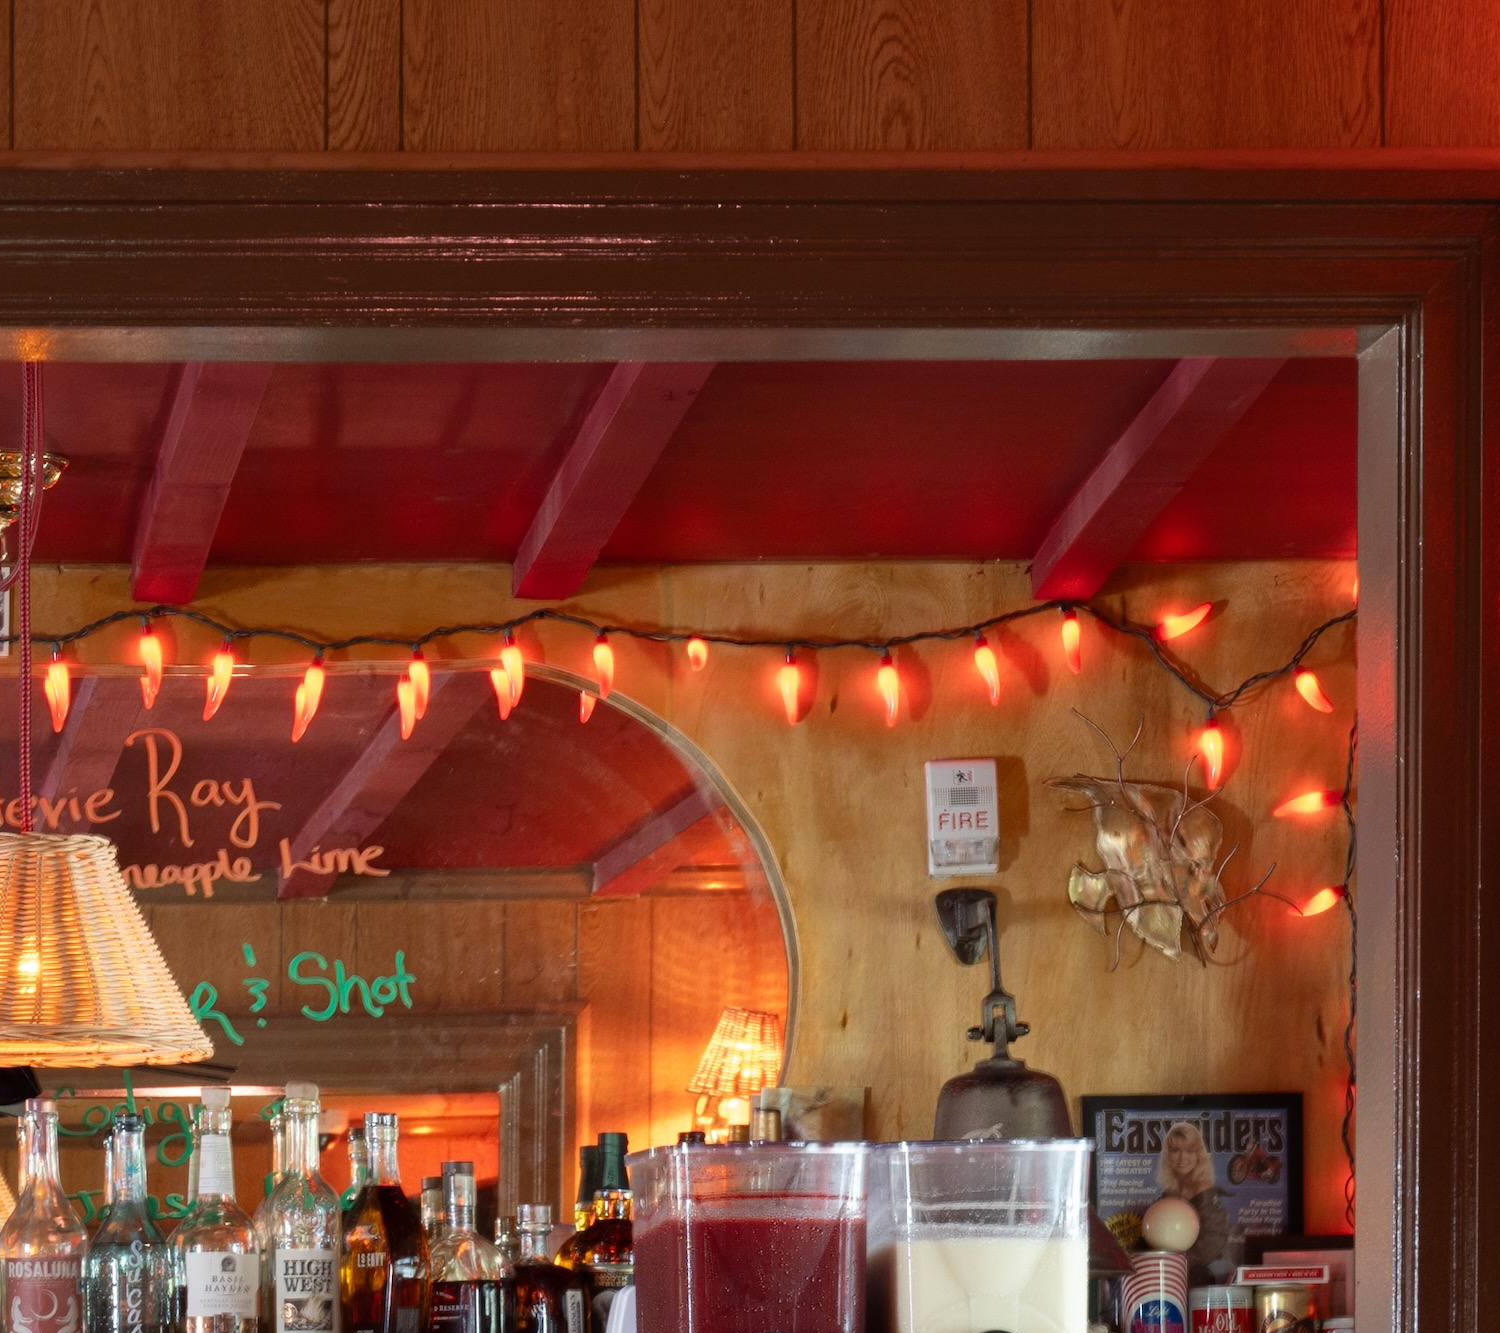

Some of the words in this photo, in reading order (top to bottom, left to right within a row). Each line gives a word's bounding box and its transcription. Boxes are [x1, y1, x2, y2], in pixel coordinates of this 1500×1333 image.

[124, 727, 282, 848] Ray
[938, 810, 989, 832] FIRE
[280, 837, 390, 877] Lime
[289, 948, 417, 1021] Shot
[8, 1260, 79, 1279] ROSALUNA
[283, 1258, 333, 1277] HIGH
[212, 1275, 246, 1284] BASIL
[284, 1277, 333, 1294] WEST
[1214, 1312, 1238, 1332] Old
